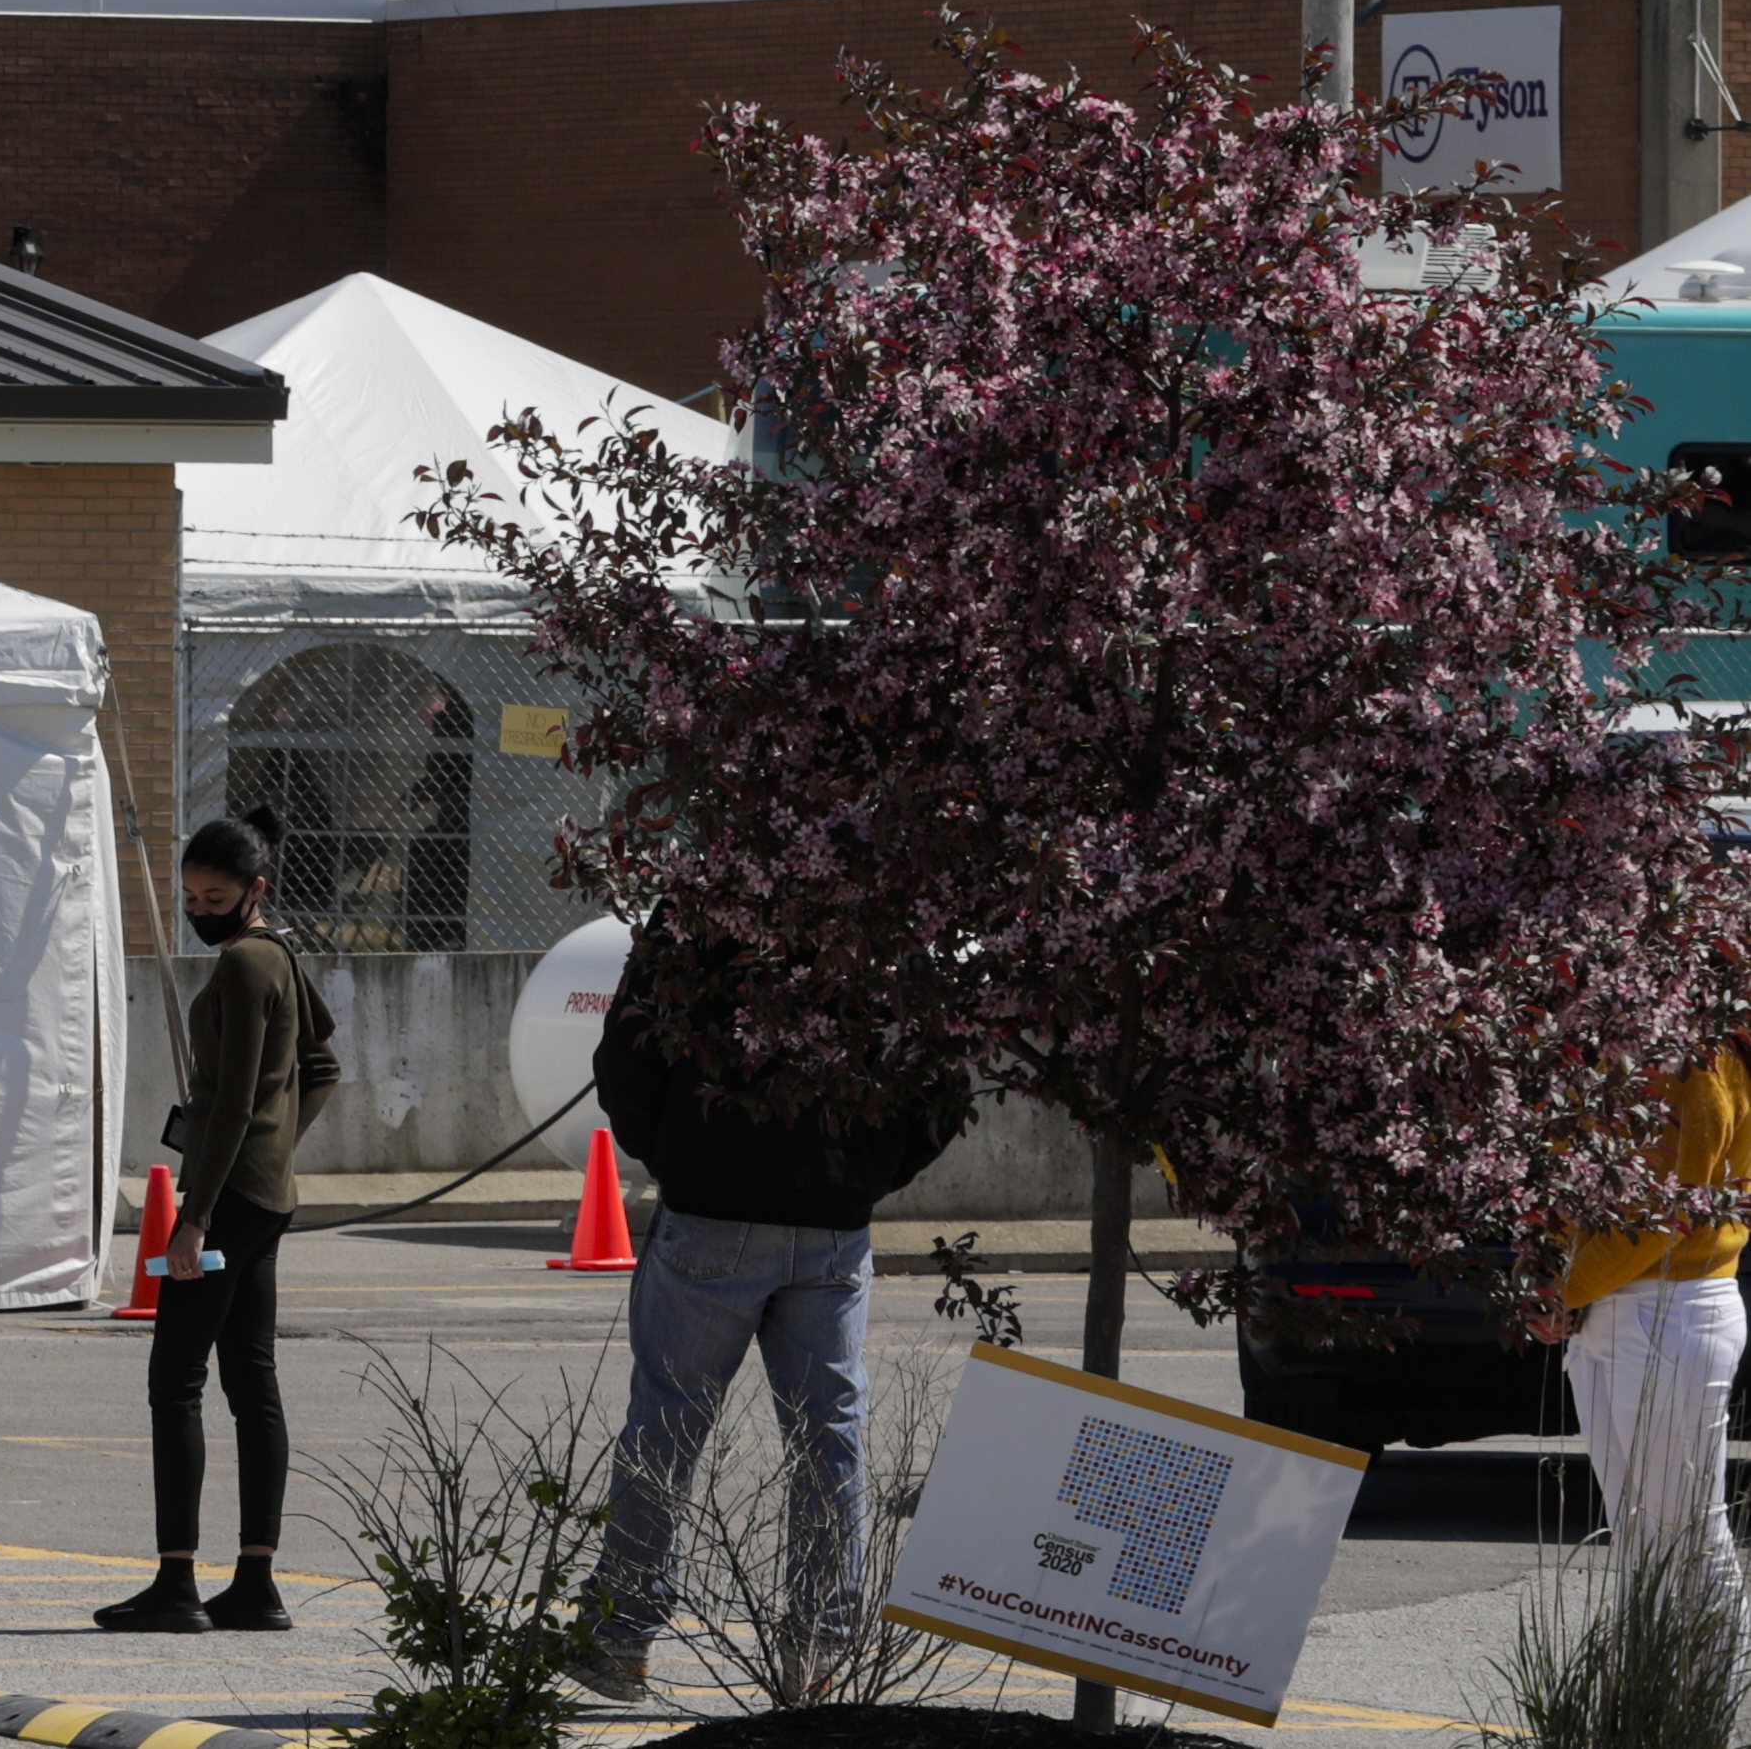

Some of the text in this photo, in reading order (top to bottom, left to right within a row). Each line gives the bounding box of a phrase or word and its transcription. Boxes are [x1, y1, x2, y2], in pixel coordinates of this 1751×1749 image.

[1452, 67, 1548, 133] Tyson
[526, 712, 546, 728] NO
[1033, 1533, 1095, 1564] Census
[1038, 1552, 1083, 1576] 2020
[938, 1573, 1251, 1678] #YouCountINCassCounty
